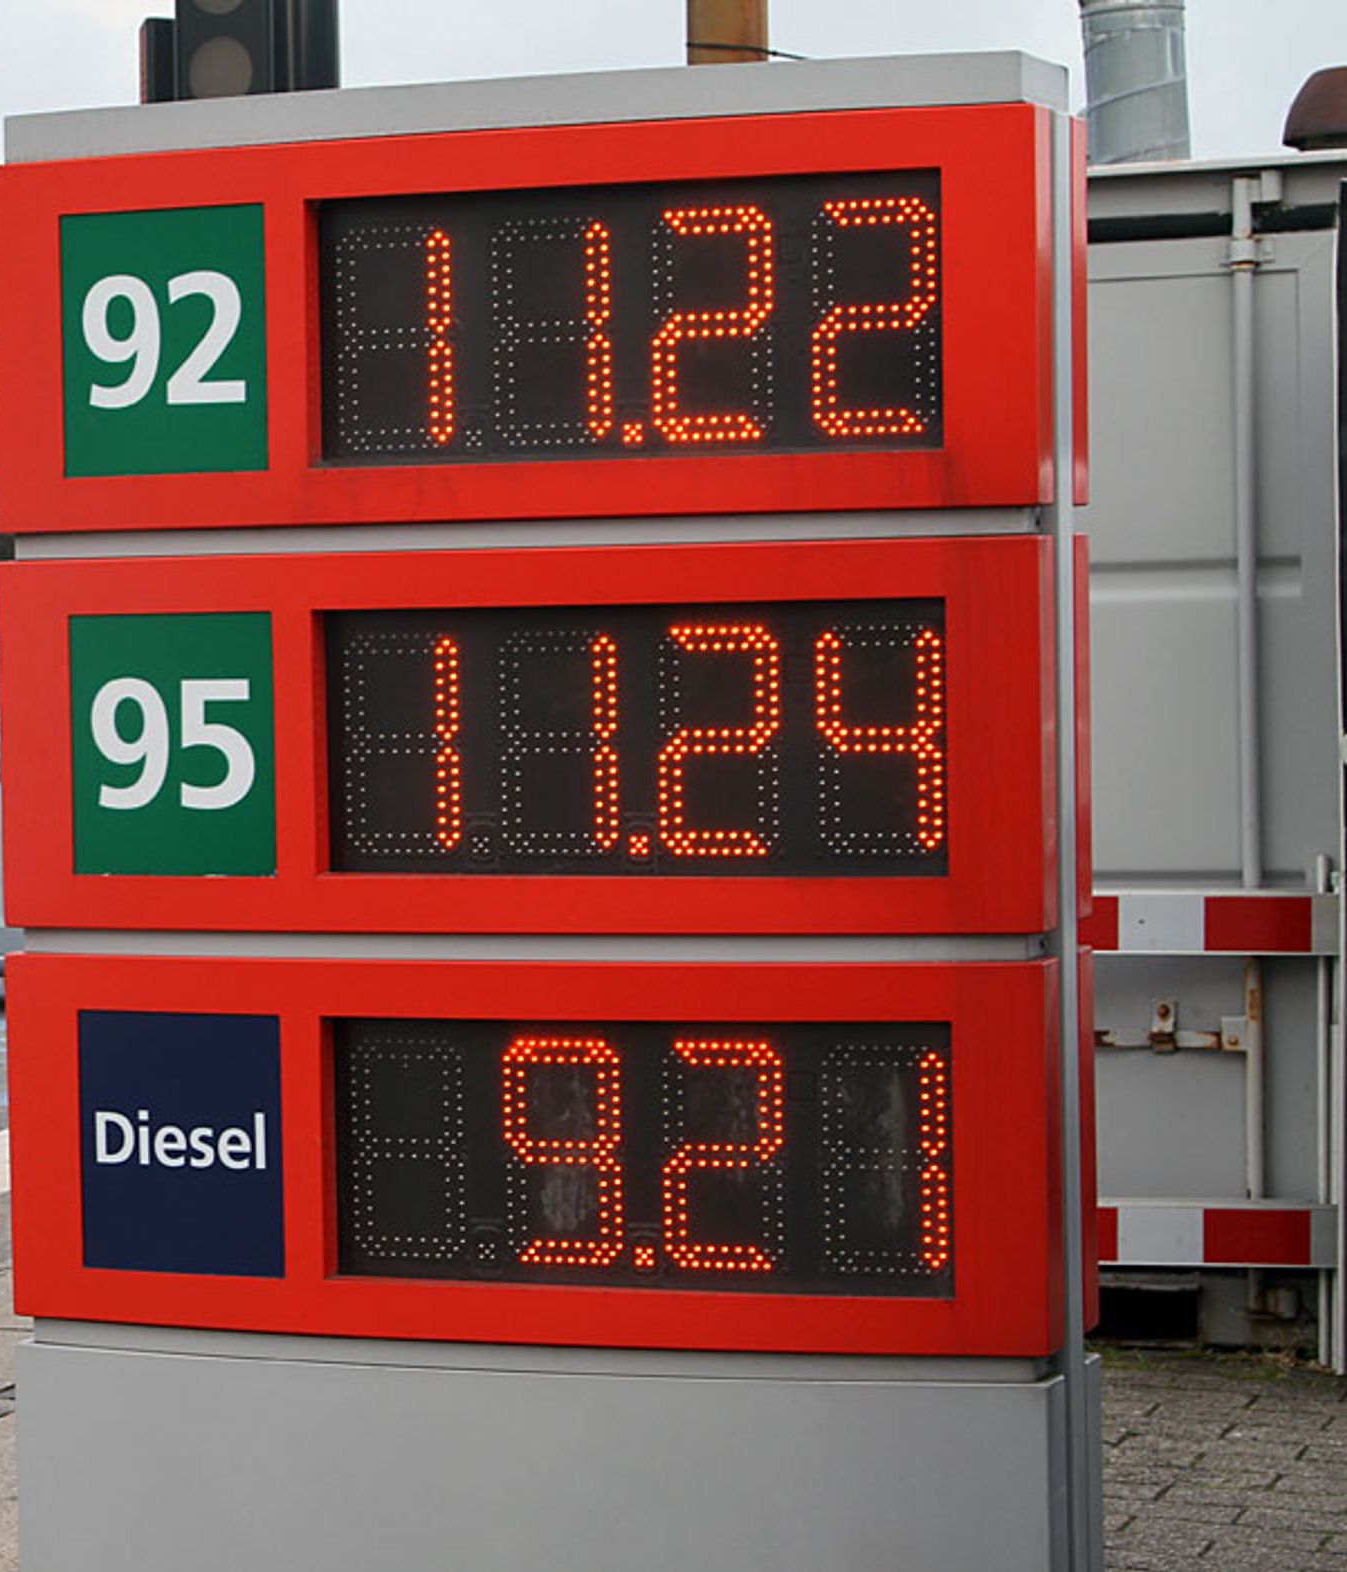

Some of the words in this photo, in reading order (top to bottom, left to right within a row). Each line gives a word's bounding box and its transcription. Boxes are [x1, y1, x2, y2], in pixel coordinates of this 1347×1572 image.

[82, 270, 247, 409] 92
[427, 197, 937, 444] 11.22
[90, 677, 256, 810] 95
[434, 624, 944, 856] 11.24
[94, 1109, 267, 1170] Diesel
[502, 1038, 948, 1271] 9.21
